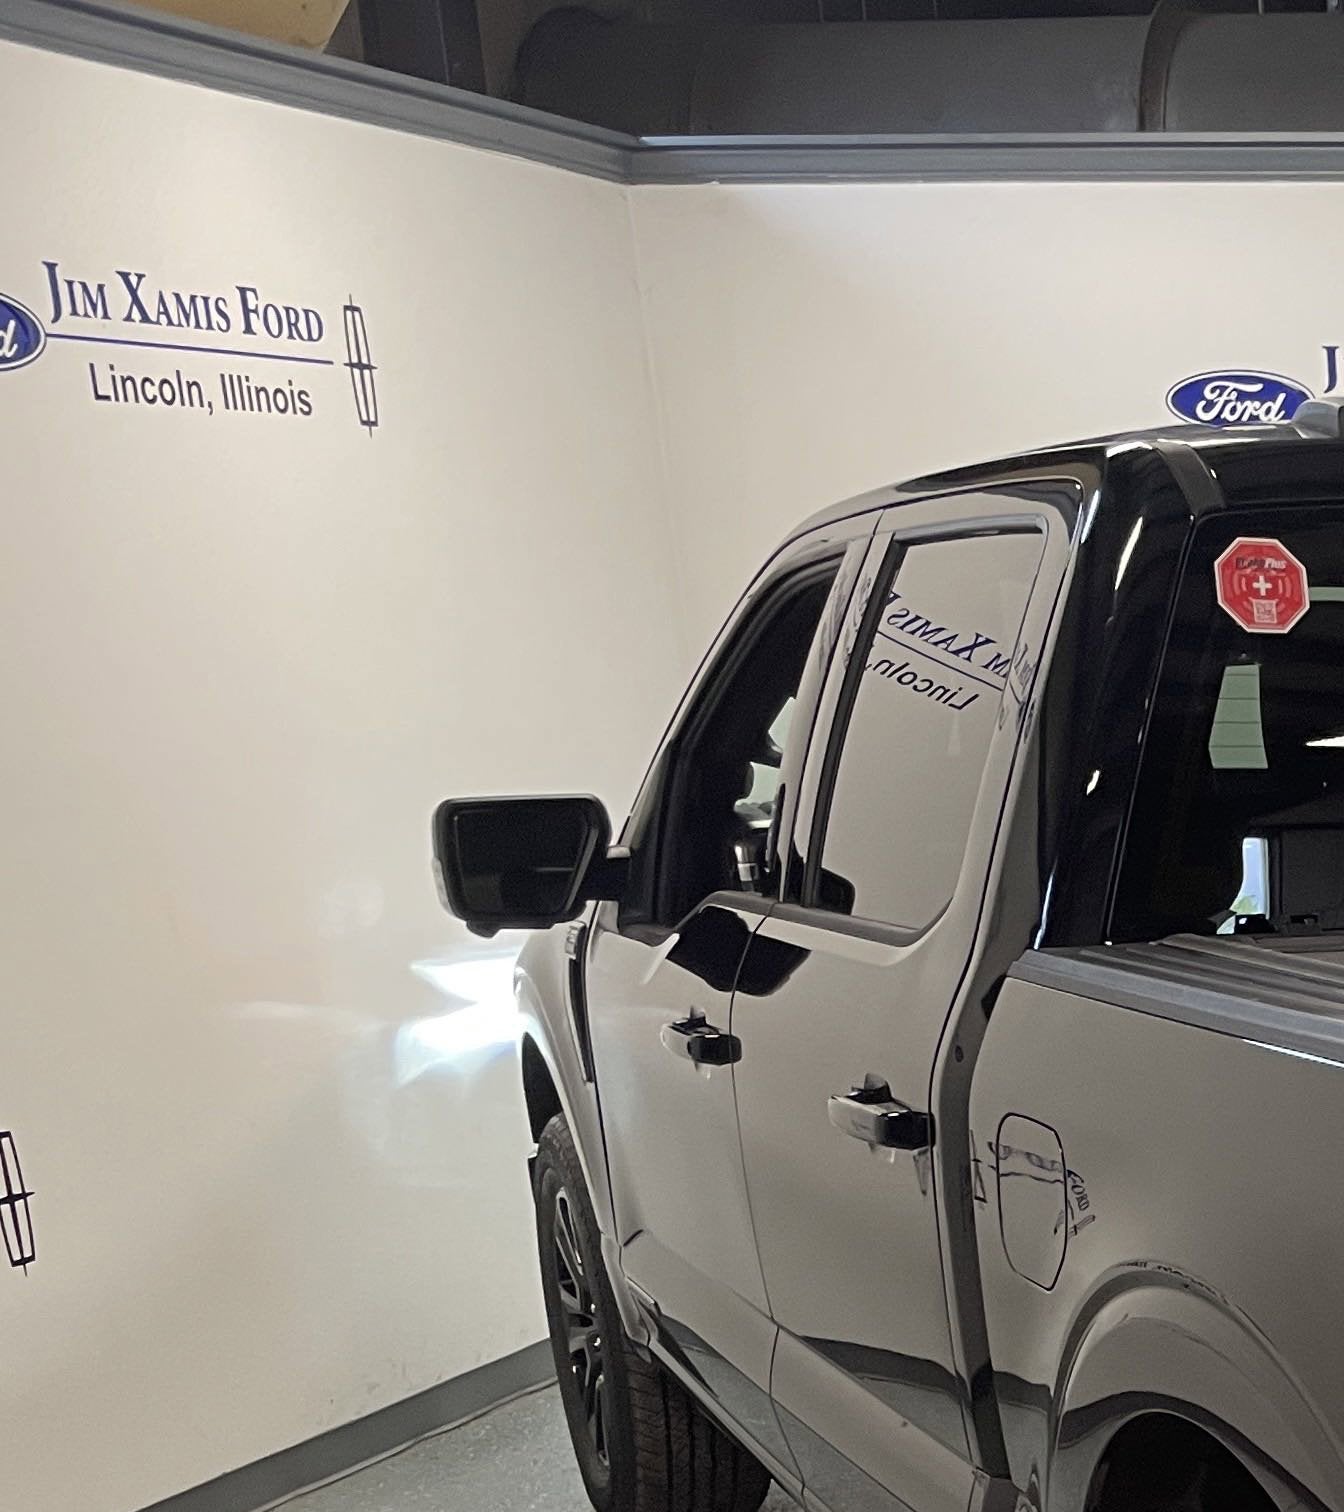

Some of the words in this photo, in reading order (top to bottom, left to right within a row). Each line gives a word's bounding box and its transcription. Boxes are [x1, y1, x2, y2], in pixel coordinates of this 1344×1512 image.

[42, 261, 112, 324] JIM
[115, 270, 231, 334] XAMIS
[235, 286, 325, 343] FORD
[89, 362, 215, 416] Lincoln,
[220, 373, 313, 416] Illinois
[1195, 380, 1287, 423] Ford
